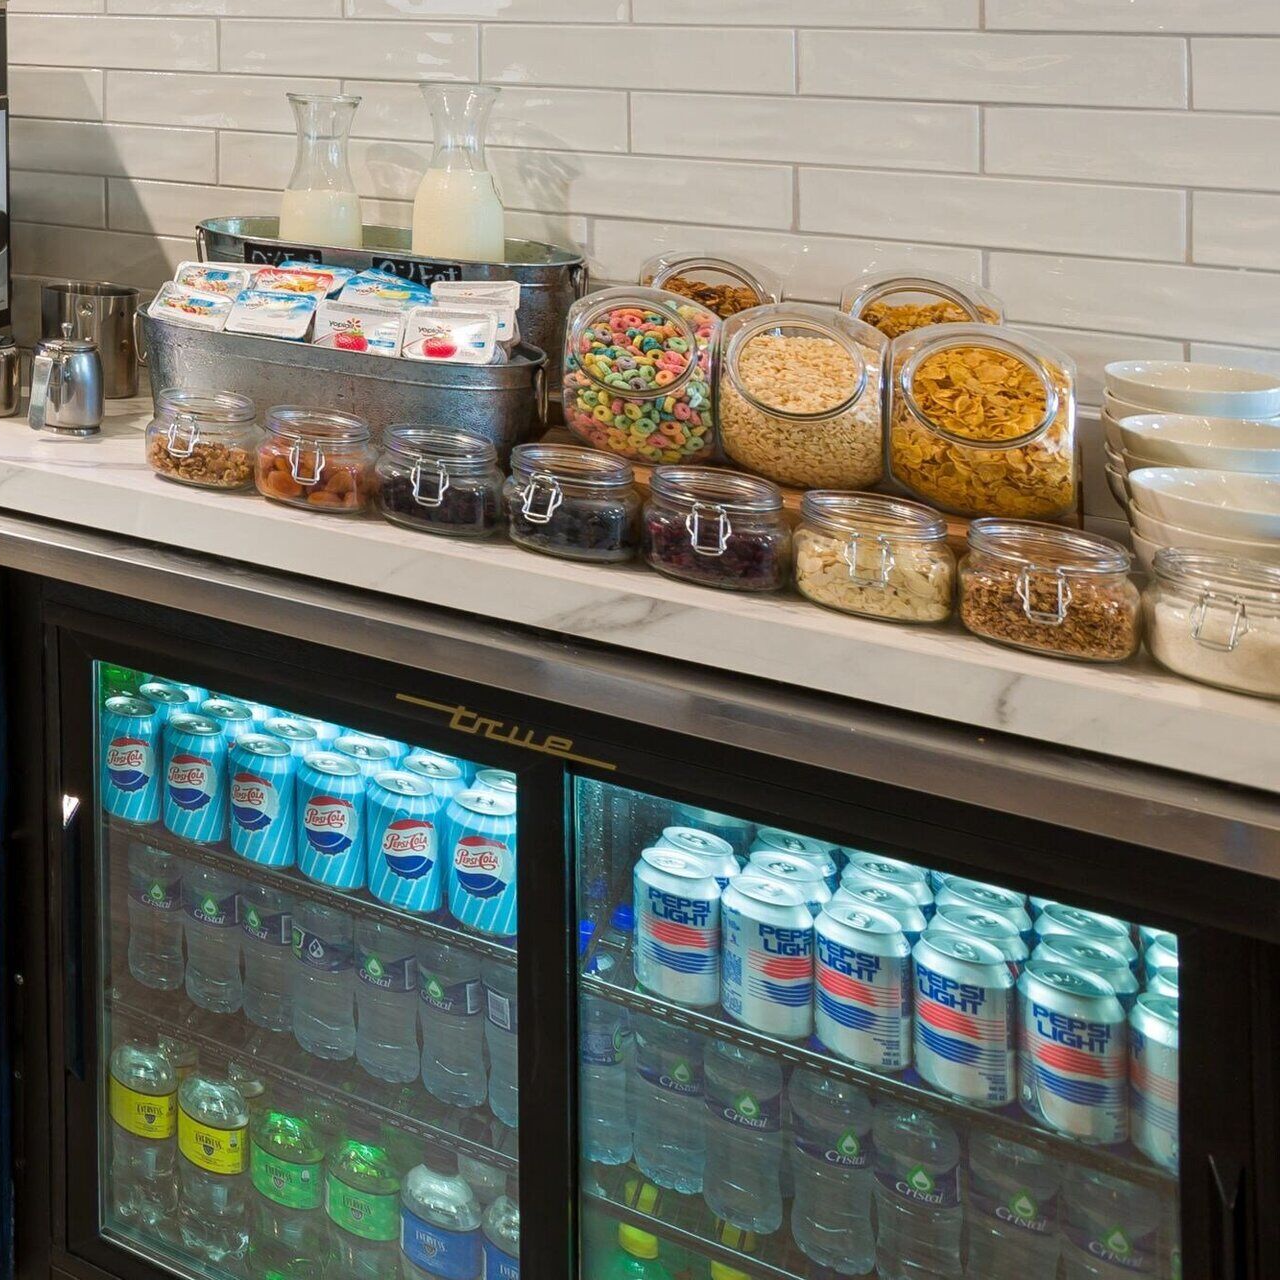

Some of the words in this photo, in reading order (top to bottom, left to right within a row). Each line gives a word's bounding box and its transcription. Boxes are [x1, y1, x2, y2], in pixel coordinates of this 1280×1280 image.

[141, 893, 172, 909] Cristal
[649, 886, 711, 914] PEPSI
[194, 909, 225, 925] Cristal
[651, 901, 709, 927] LIGHT
[758, 923, 813, 941] PEPS
[816, 932, 881, 971] PEPSI
[359, 967, 392, 988] Cristal
[818, 948, 878, 983] LIGHT
[916, 962, 987, 1002] PEPSI
[420, 989, 454, 1011] Cristal
[919, 979, 983, 1015] LIGHT
[1032, 1003, 1111, 1040] PEPSI
[1037, 1019, 1108, 1054] LIGHT
[723, 1107, 768, 1129] Cristal
[895, 1180, 944, 1204] Cristal
[995, 1206, 1047, 1232] Cristal
[1088, 1240, 1144, 1266] Cristal
